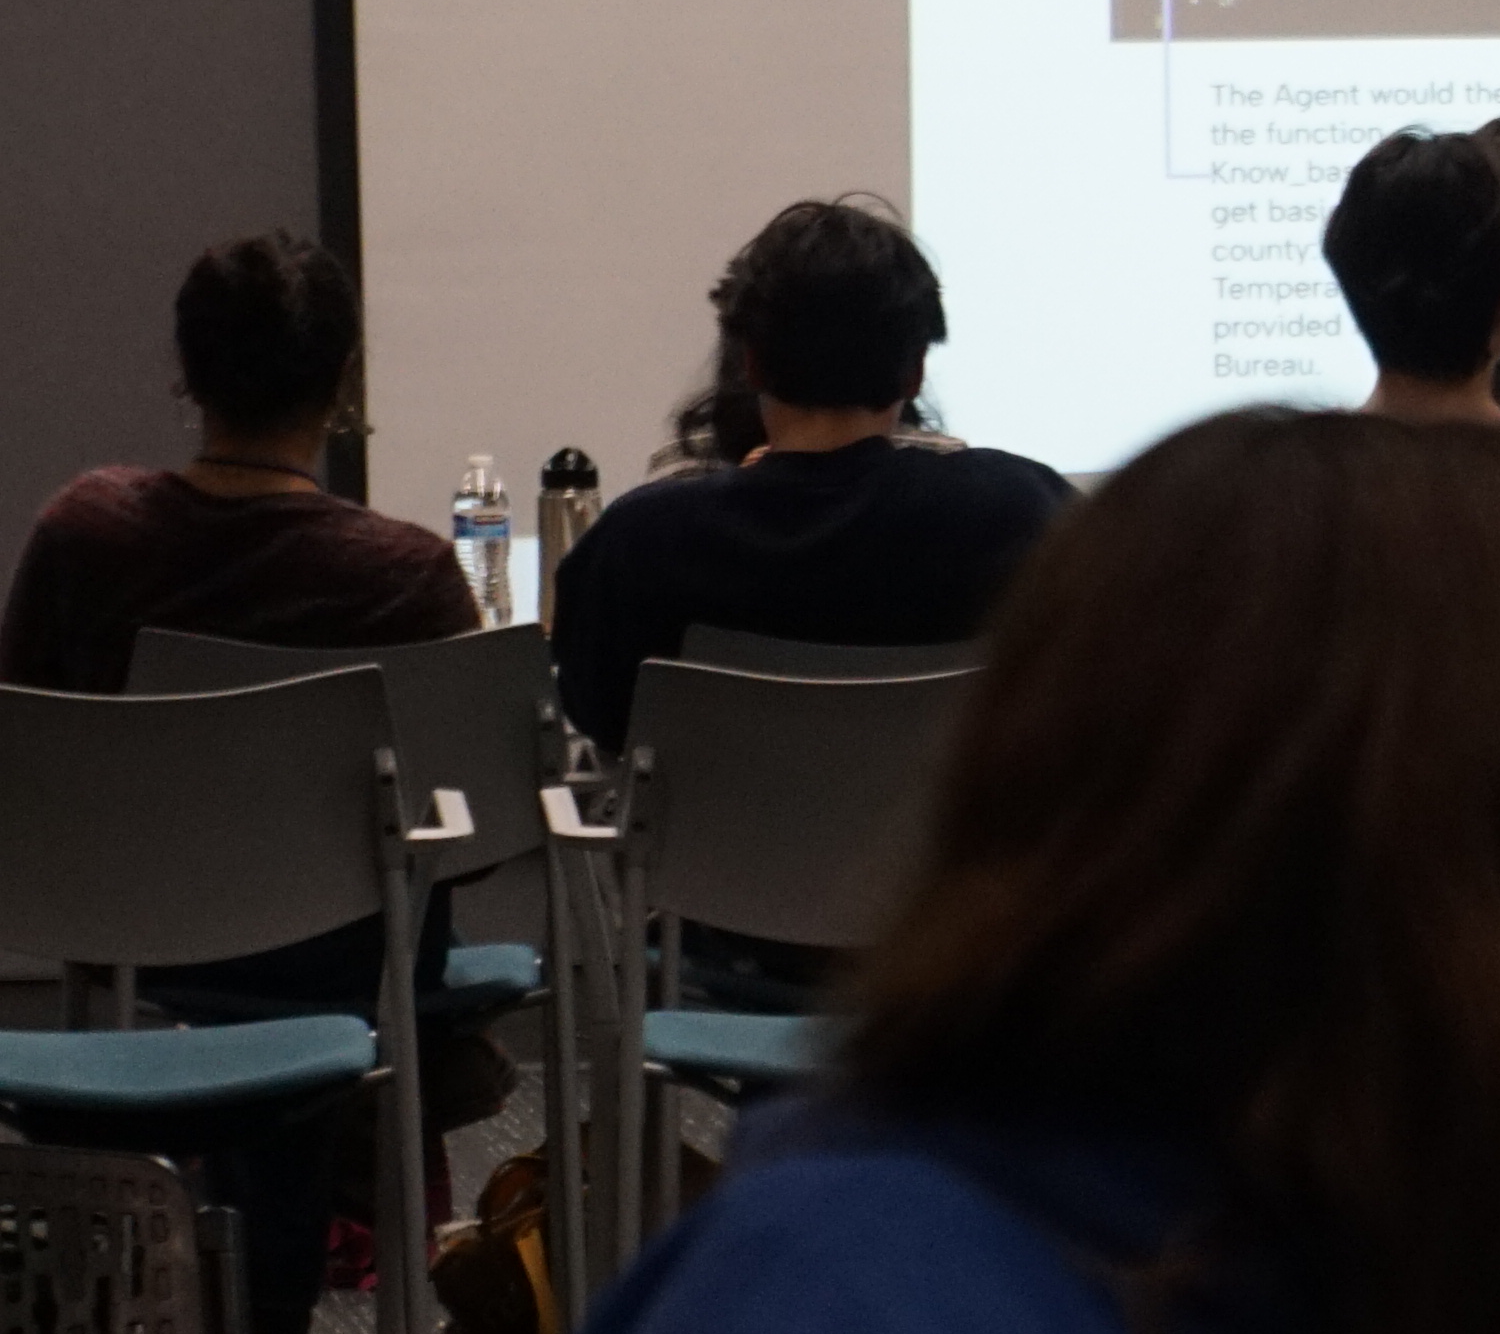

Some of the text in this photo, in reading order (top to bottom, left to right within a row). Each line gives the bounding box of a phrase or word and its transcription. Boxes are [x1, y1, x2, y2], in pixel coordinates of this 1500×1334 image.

[1210, 83, 1263, 108] The
[1273, 83, 1360, 113] Agent
[1370, 81, 1455, 107] would
[1210, 120, 1383, 147] the function
[1210, 202, 1258, 230] get
[1212, 313, 1343, 344] provided
[1213, 352, 1323, 378] Bureau.
